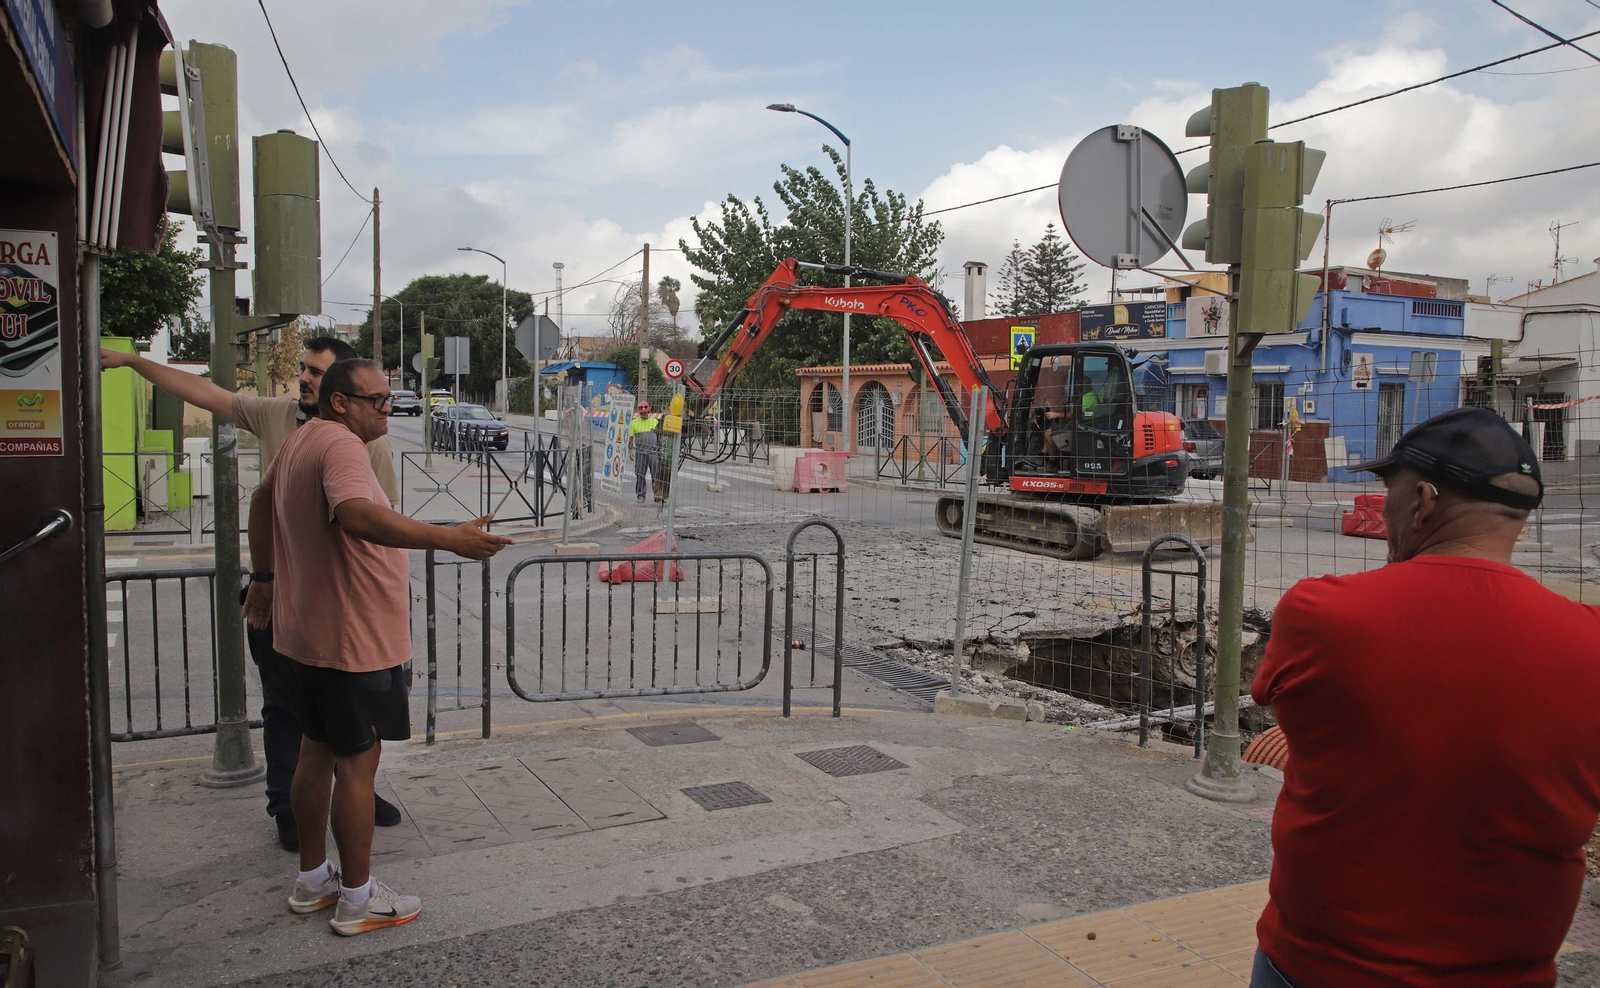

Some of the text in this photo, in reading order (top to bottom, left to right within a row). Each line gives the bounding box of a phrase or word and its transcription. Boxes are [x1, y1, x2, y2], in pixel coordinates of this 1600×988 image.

[824, 296, 865, 310] Kubota
[669, 365, 681, 373] 30
[8, 421, 41, 429] orange
